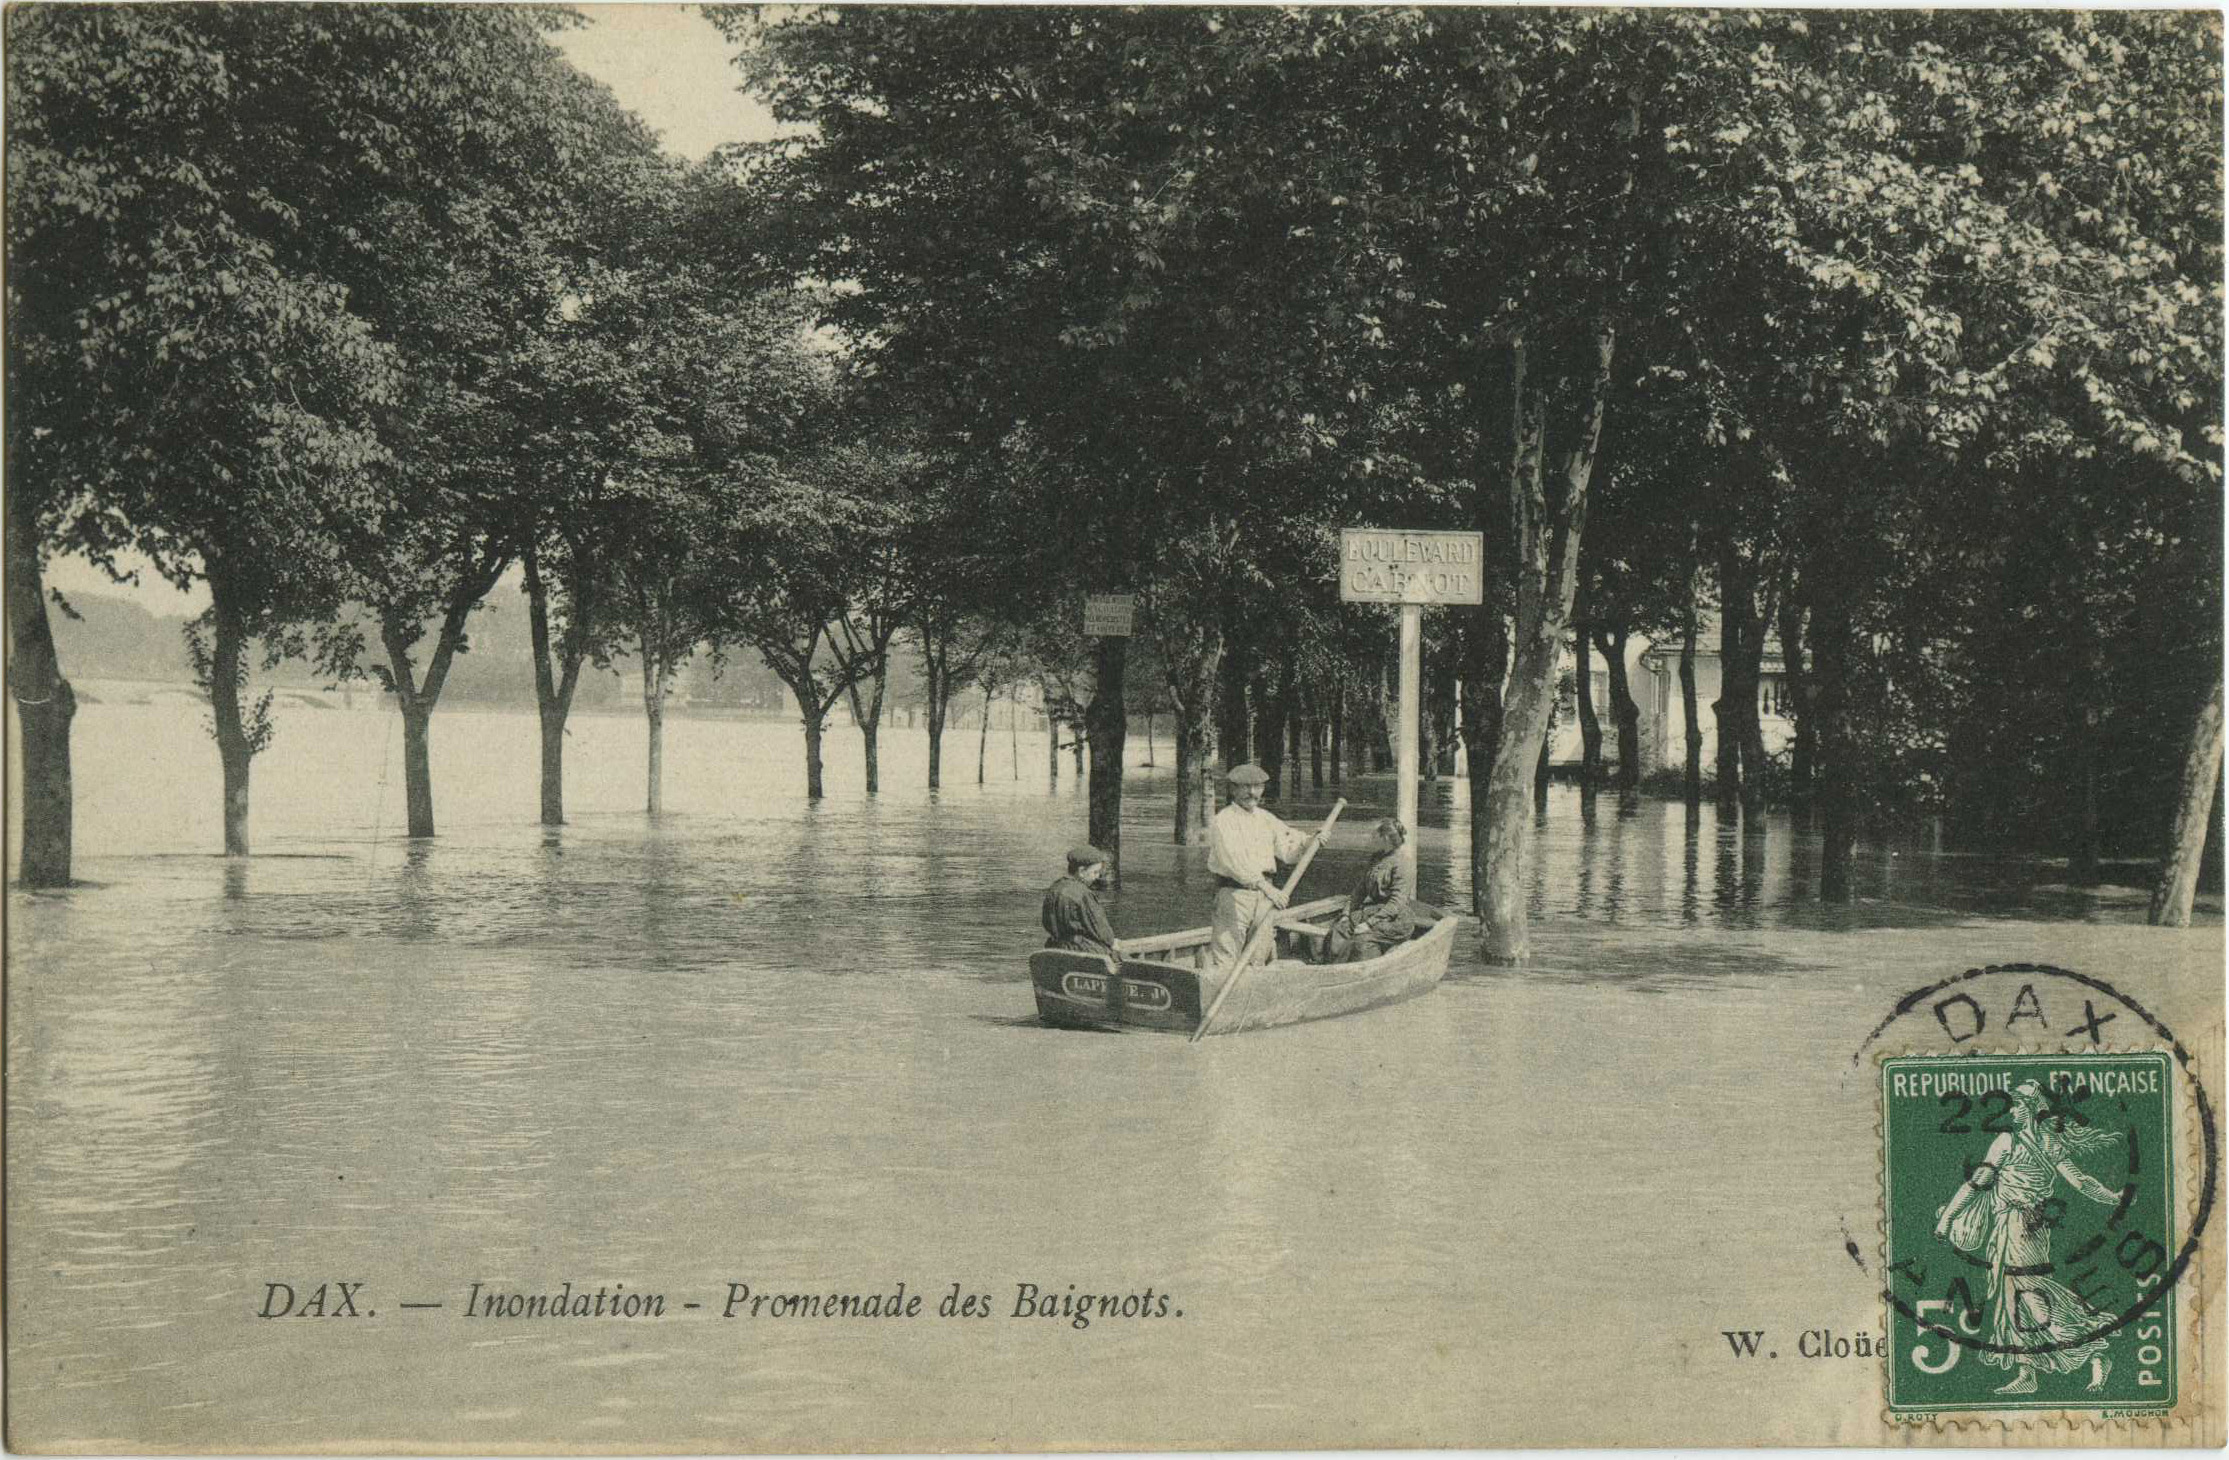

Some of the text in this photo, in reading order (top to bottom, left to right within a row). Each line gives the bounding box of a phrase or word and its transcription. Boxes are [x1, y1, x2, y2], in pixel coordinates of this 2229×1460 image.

[1346, 540, 1474, 564] BOULEVARD
[1933, 984, 2117, 1045] DAX
[2050, 1070, 2159, 1098] FRANÇAISE
